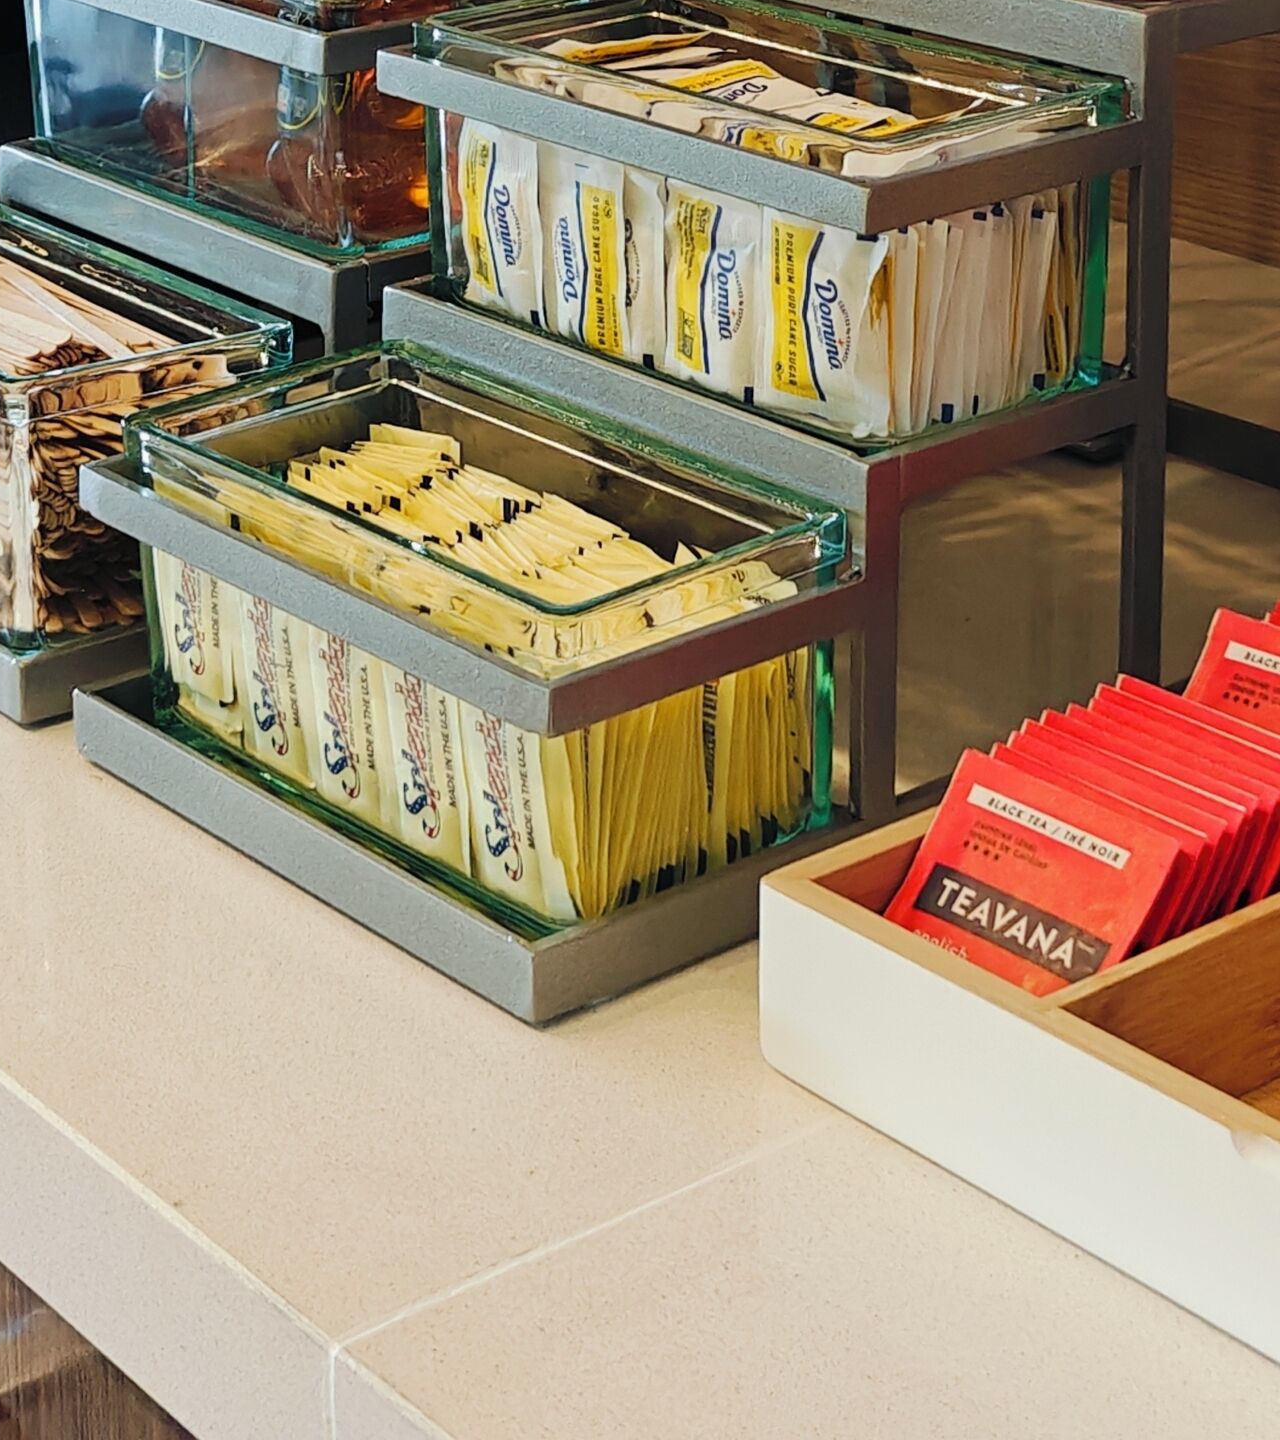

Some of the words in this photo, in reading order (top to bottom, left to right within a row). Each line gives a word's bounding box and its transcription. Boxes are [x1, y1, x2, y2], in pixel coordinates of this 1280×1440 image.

[493, 184, 517, 268] Domino
[559, 215, 580, 304] Domino
[716, 248, 737, 341] Domino
[813, 278, 844, 371] Domino
[211, 616, 220, 649] MADE
[285, 657, 295, 679] THE
[1243, 650, 1280, 674] BLACK
[288, 681, 297, 695] IN
[290, 696, 301, 729] MADE
[362, 697, 371, 721] THE
[364, 723, 372, 737] IN
[441, 731, 451, 755] THE
[365, 739, 376, 771] MADE
[445, 757, 453, 771] IN
[446, 772, 457, 809] MADE
[520, 770, 529, 795] THE
[522, 797, 532, 812] IN
[524, 814, 536, 850] MADE
[987, 796, 1023, 820] BLACK
[1027, 810, 1048, 830] TEA
[1063, 829, 1086, 847] THÉ
[1088, 840, 1121, 863] NOIR
[936, 876, 1076, 970] TEAVANA
